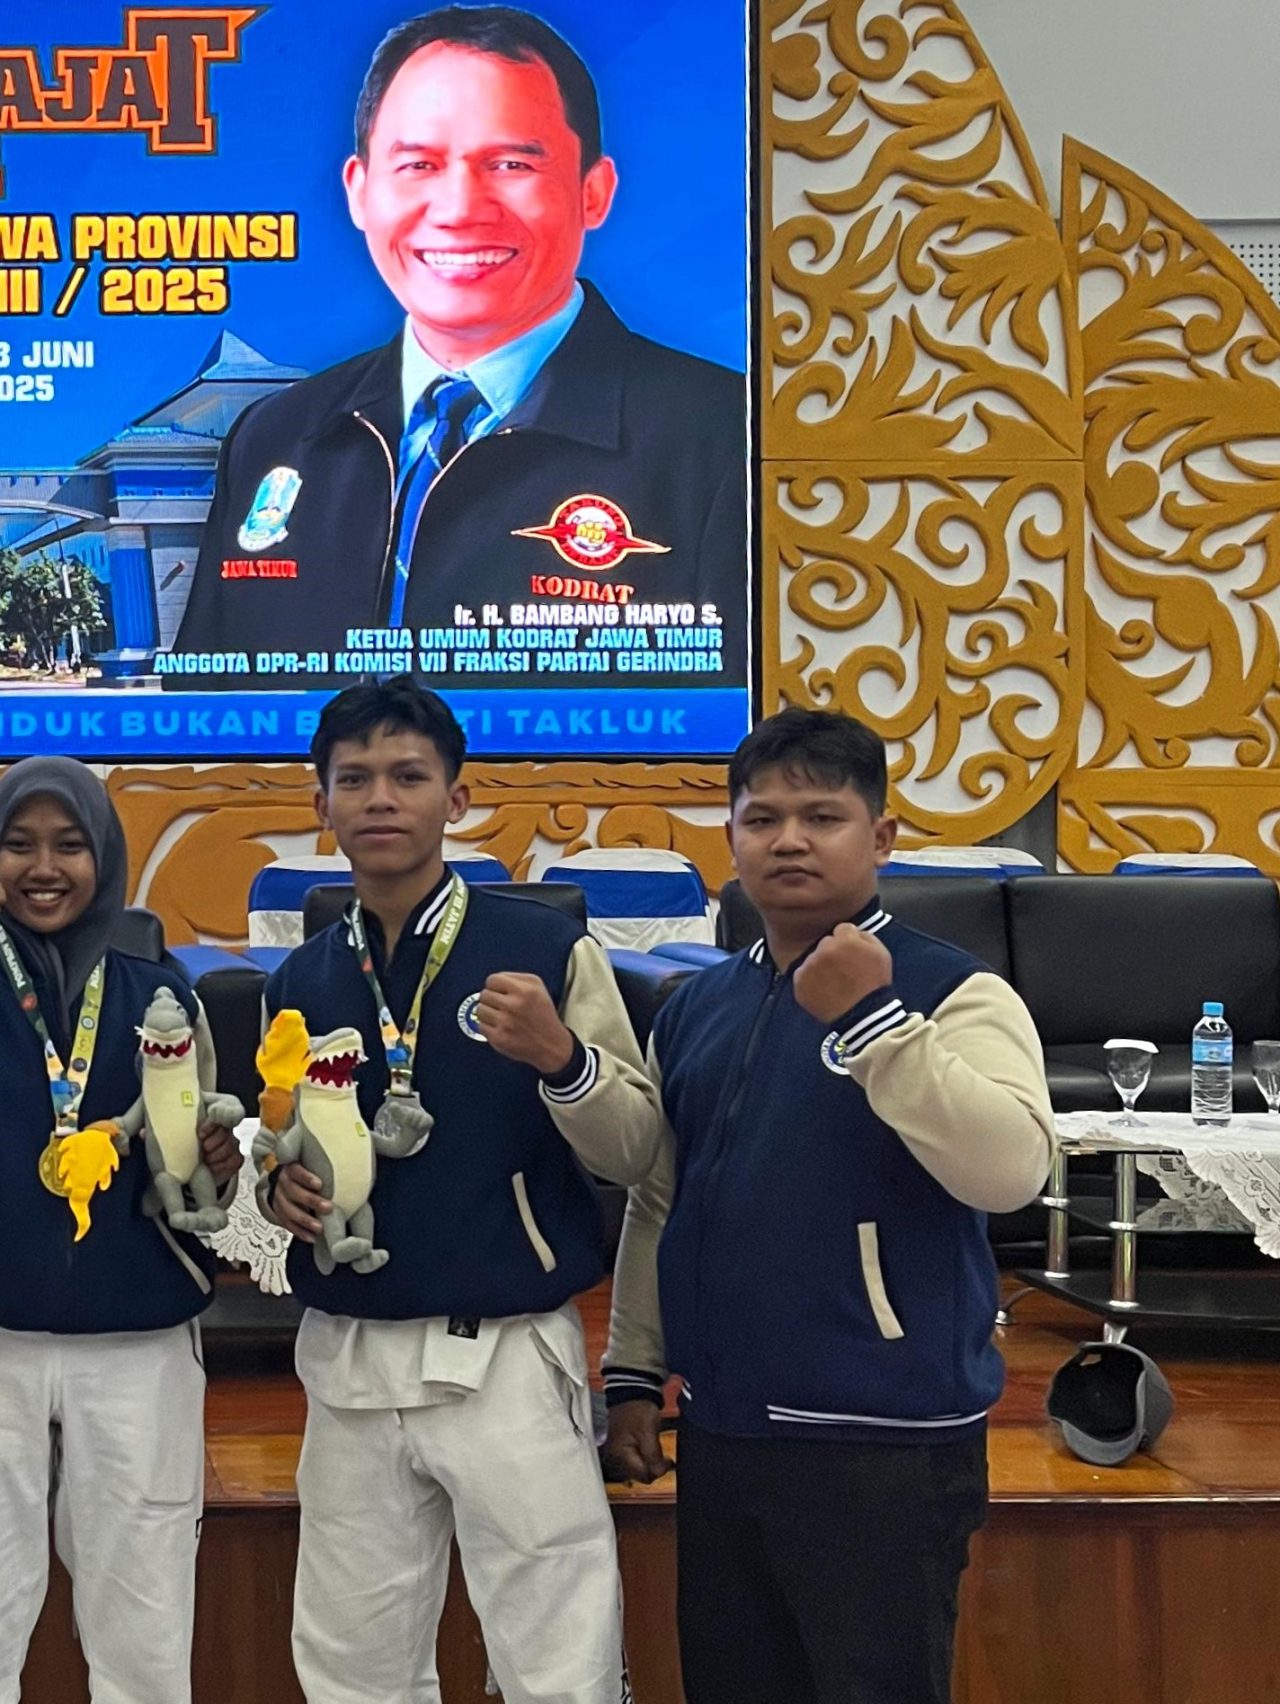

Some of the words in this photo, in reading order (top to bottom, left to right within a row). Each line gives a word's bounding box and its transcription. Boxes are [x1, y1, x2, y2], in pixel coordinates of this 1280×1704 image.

[75, 215, 295, 259] PROVINSI
[56, 269, 84, 314] /
[103, 268, 227, 312] 2025
[23, 341, 94, 368] JUNI
[531, 574, 635, 604] KODRAT
[454, 604, 476, 625] Ir.
[482, 604, 504, 625] H.
[510, 604, 619, 625] BAMBANG
[625, 604, 695, 625] HARYO
[701, 604, 723, 625] S.
[346, 628, 414, 649] KETUA
[420, 628, 490, 649] UMUM
[496, 628, 579, 649] KODRAT
[585, 628, 650, 649] JAWA
[655, 628, 723, 649] TIMUR
[153, 652, 250, 673] ANGGOTA
[256, 652, 329, 673] DPR-RI
[334, 652, 412, 673] KOMISI
[418, 652, 447, 672] VII
[454, 651, 530, 672] FRAKSI
[537, 651, 610, 672] PARTAI
[616, 651, 723, 672] GERINDRA
[121, 710, 279, 737] BUKAN
[507, 709, 687, 735] TAKLUK
